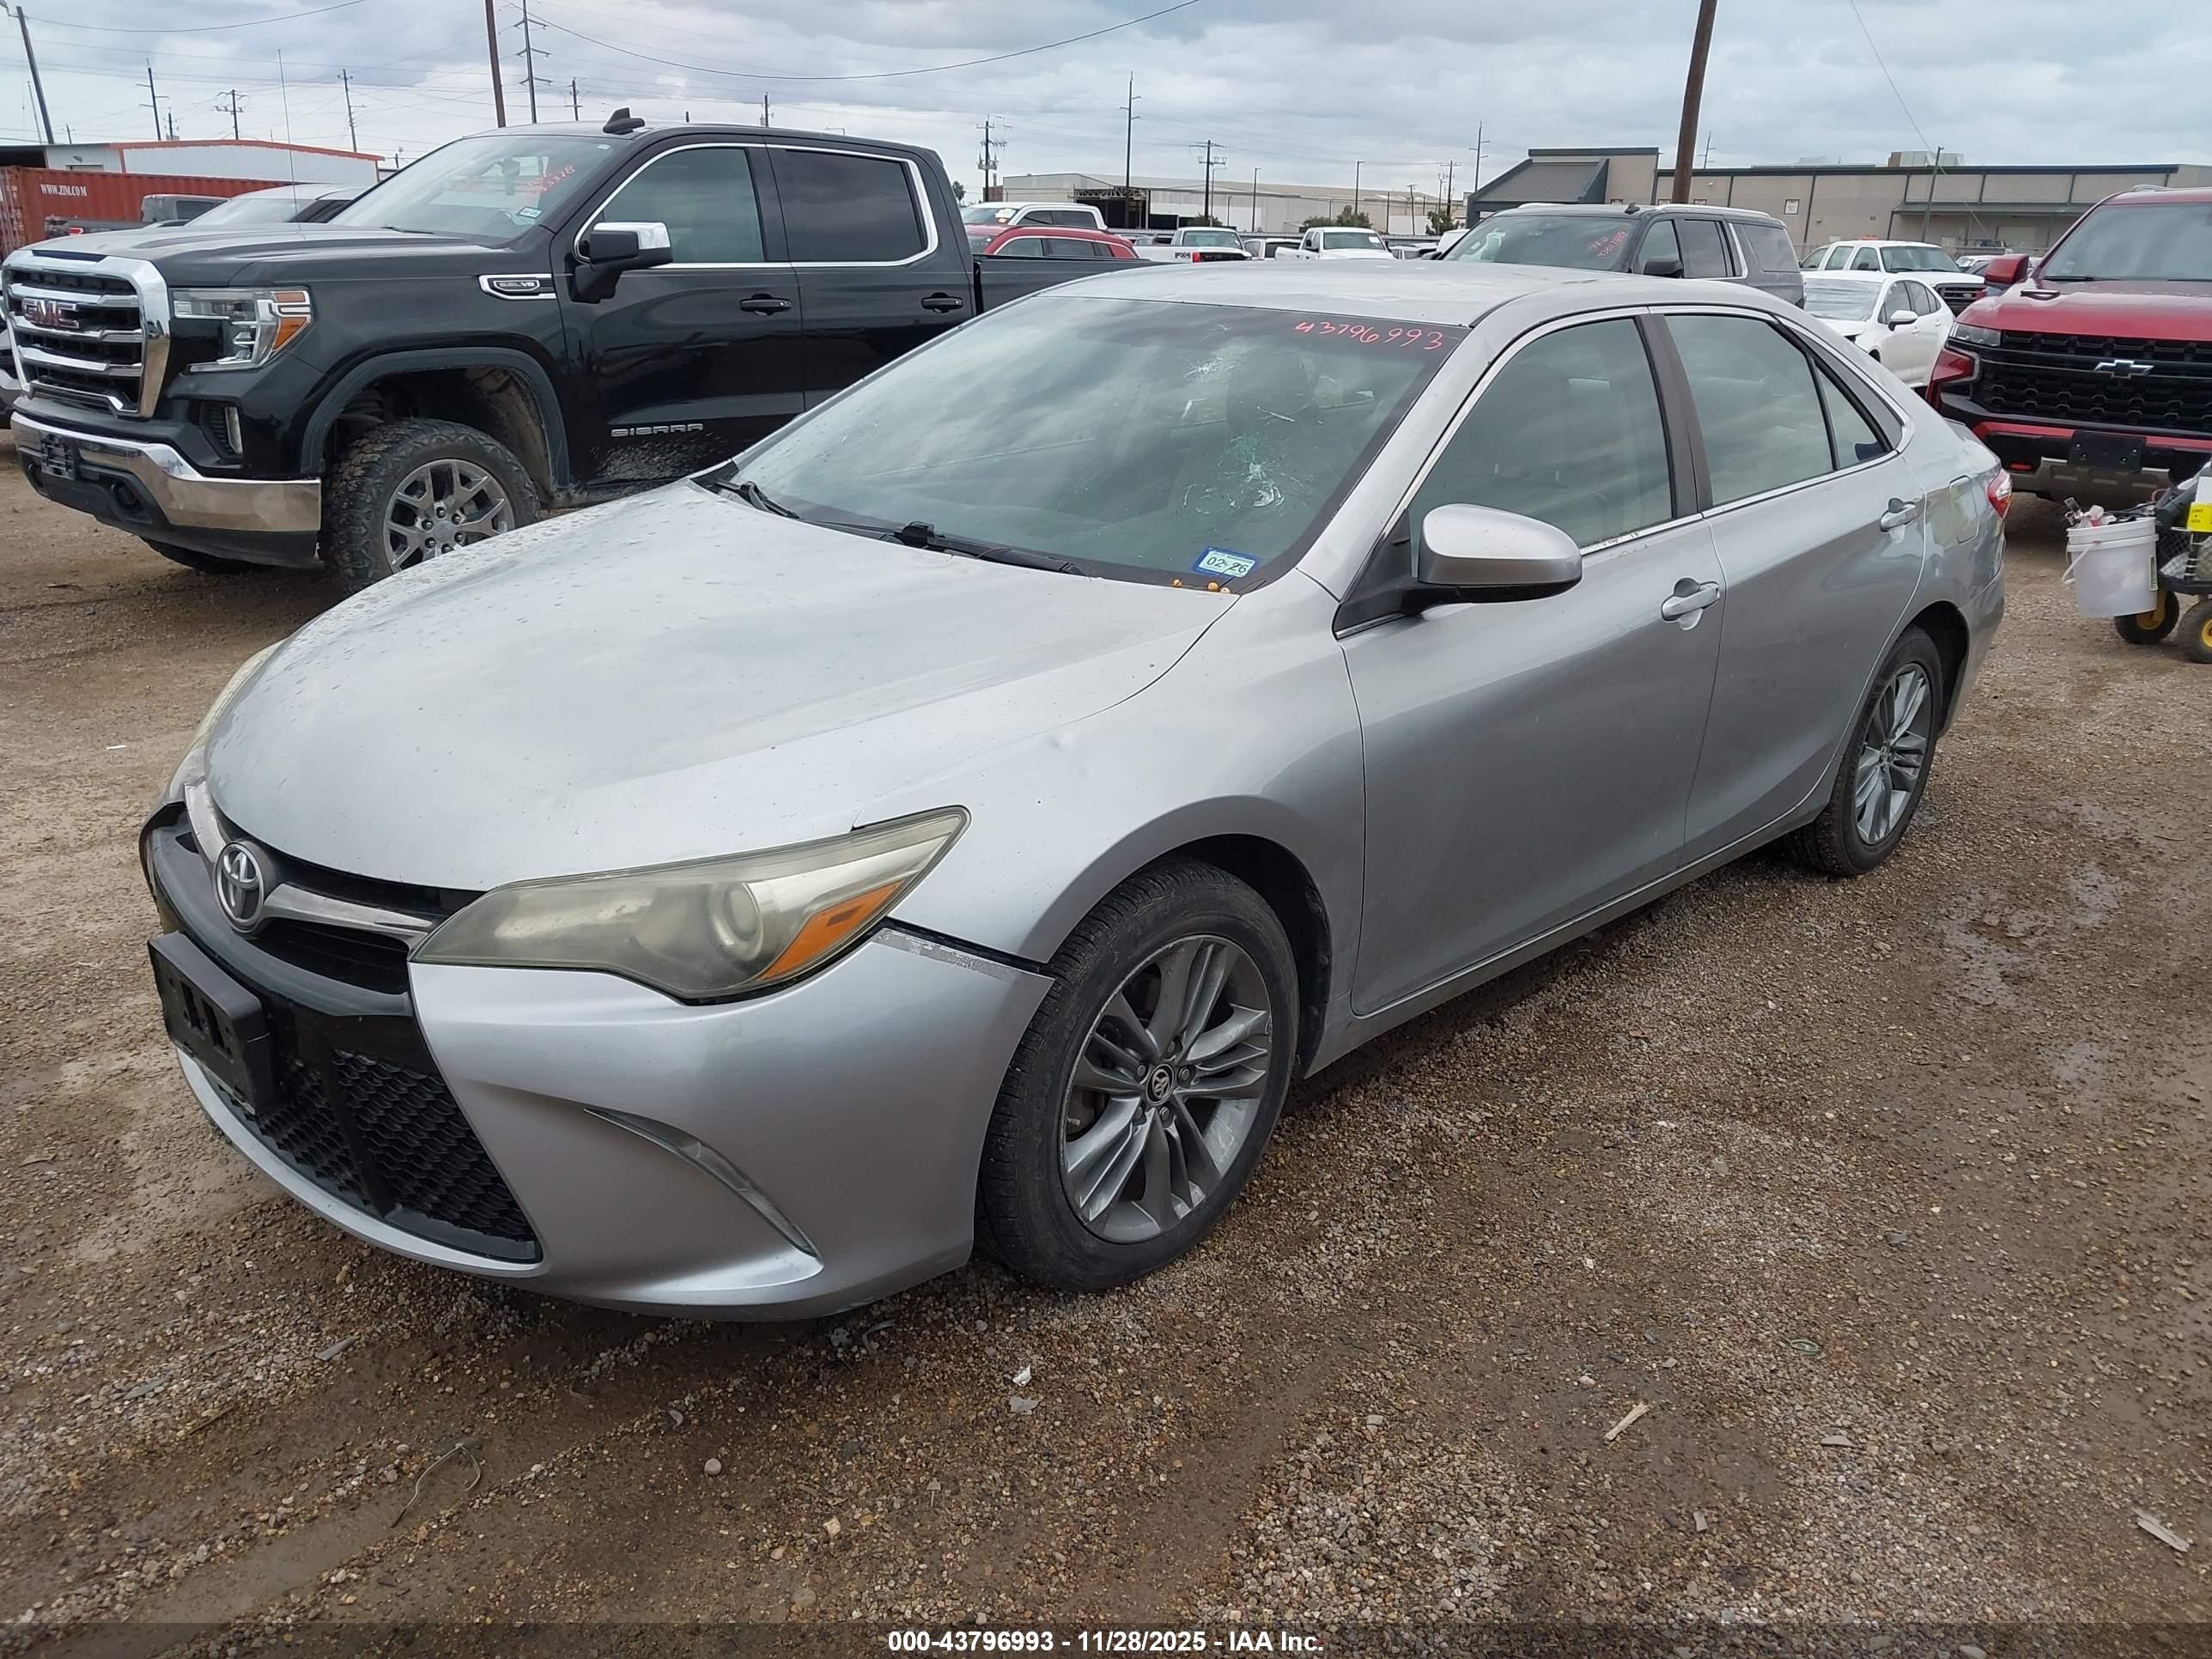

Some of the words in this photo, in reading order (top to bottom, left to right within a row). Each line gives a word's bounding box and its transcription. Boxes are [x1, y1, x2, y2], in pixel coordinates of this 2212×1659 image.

[21, 297, 80, 329] GMC
[1295, 321, 1443, 350] 43796993
[611, 423, 704, 437] SIERRA
